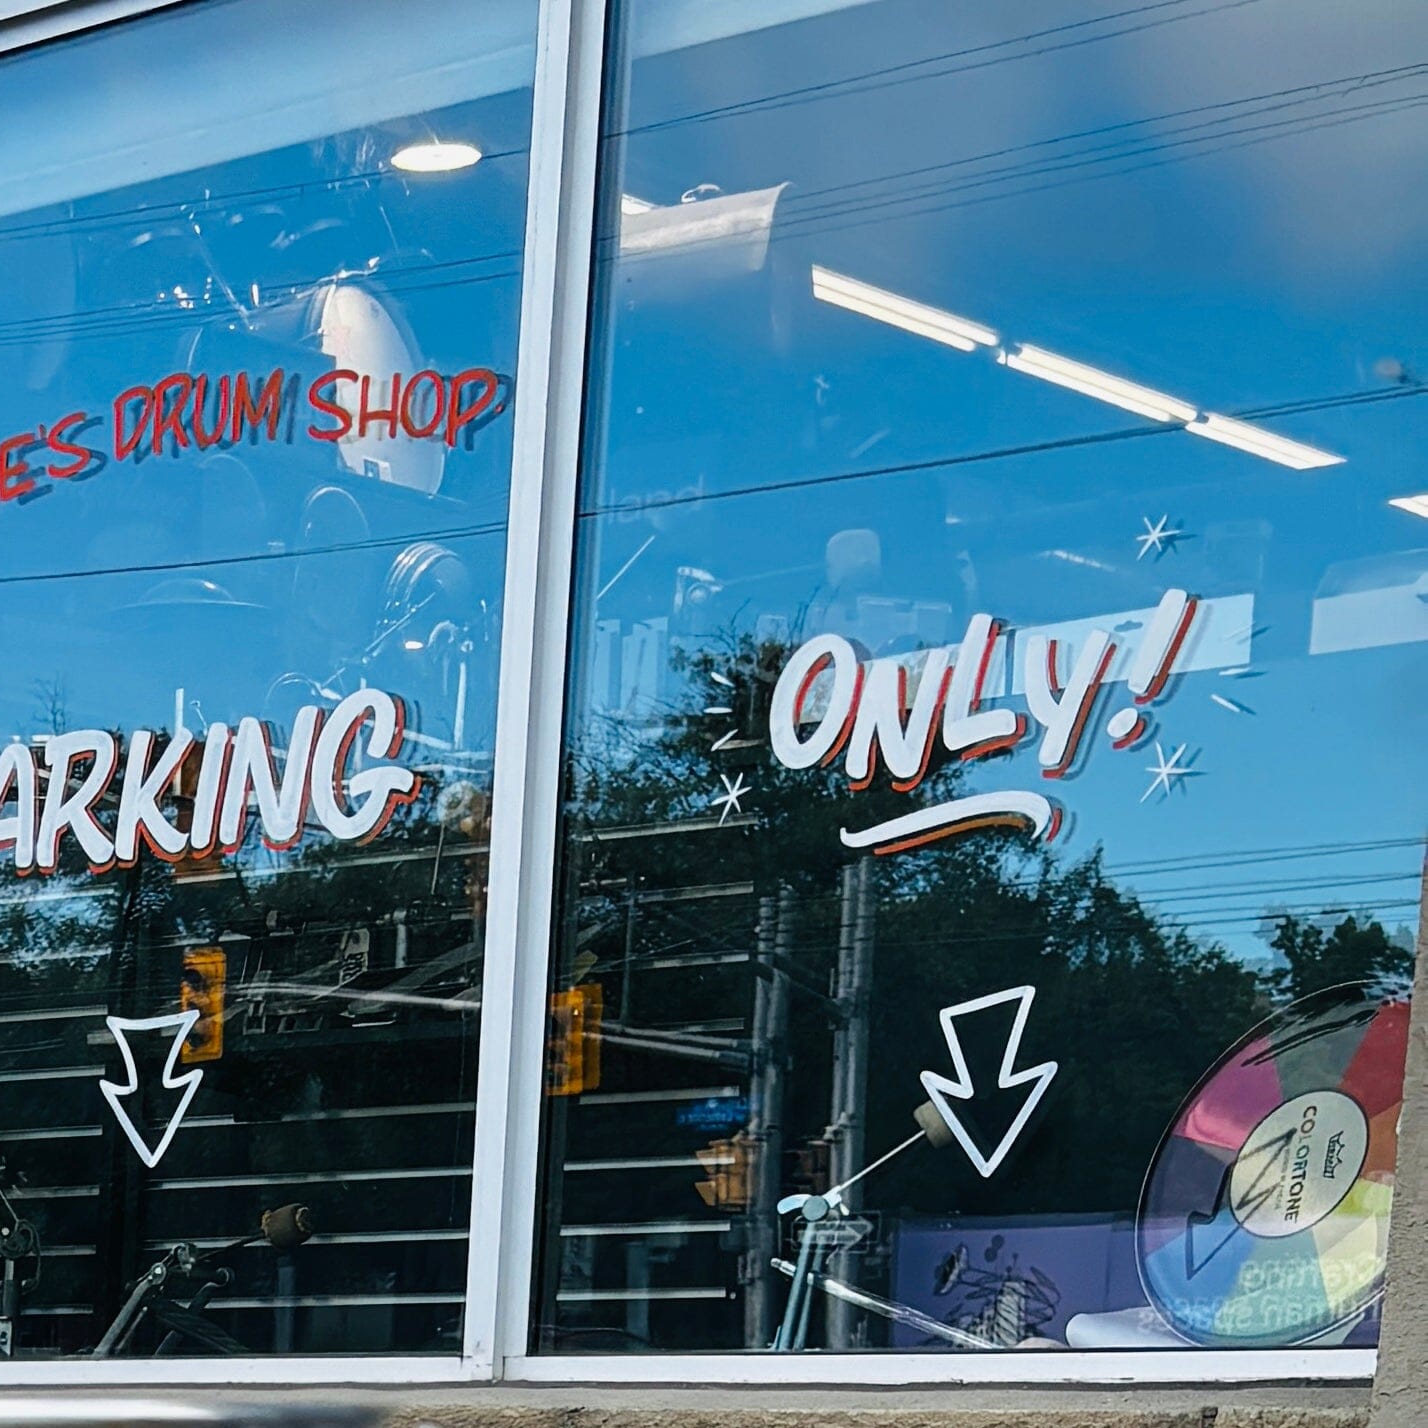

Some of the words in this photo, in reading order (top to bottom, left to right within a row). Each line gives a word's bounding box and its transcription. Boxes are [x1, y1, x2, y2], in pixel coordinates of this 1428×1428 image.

[114, 367, 283, 461] DRUM
[308, 367, 499, 448] SHOP
[769, 588, 1196, 789] ONLY!
[1284, 1105, 1318, 1223] COLORTONE
